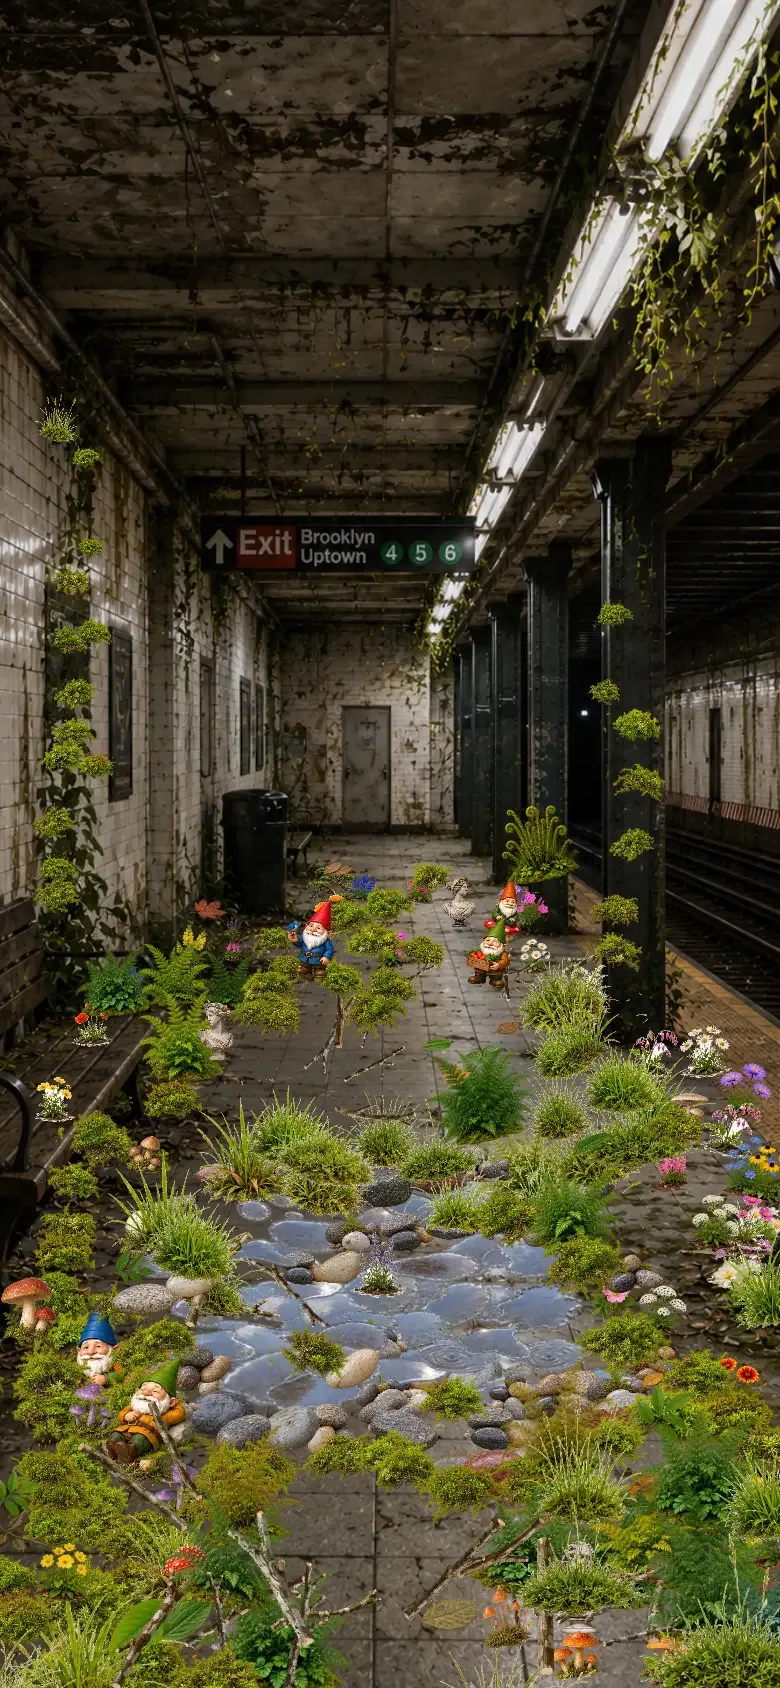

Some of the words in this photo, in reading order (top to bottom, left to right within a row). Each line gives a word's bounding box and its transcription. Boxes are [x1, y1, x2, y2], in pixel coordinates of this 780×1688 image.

[239, 529, 293, 556] Exit
[300, 528, 376, 549] Brooklyn
[300, 548, 368, 568] Uptown
[385, 544, 398, 561] 4
[415, 544, 427, 562] 5
[444, 544, 457, 562] 6
